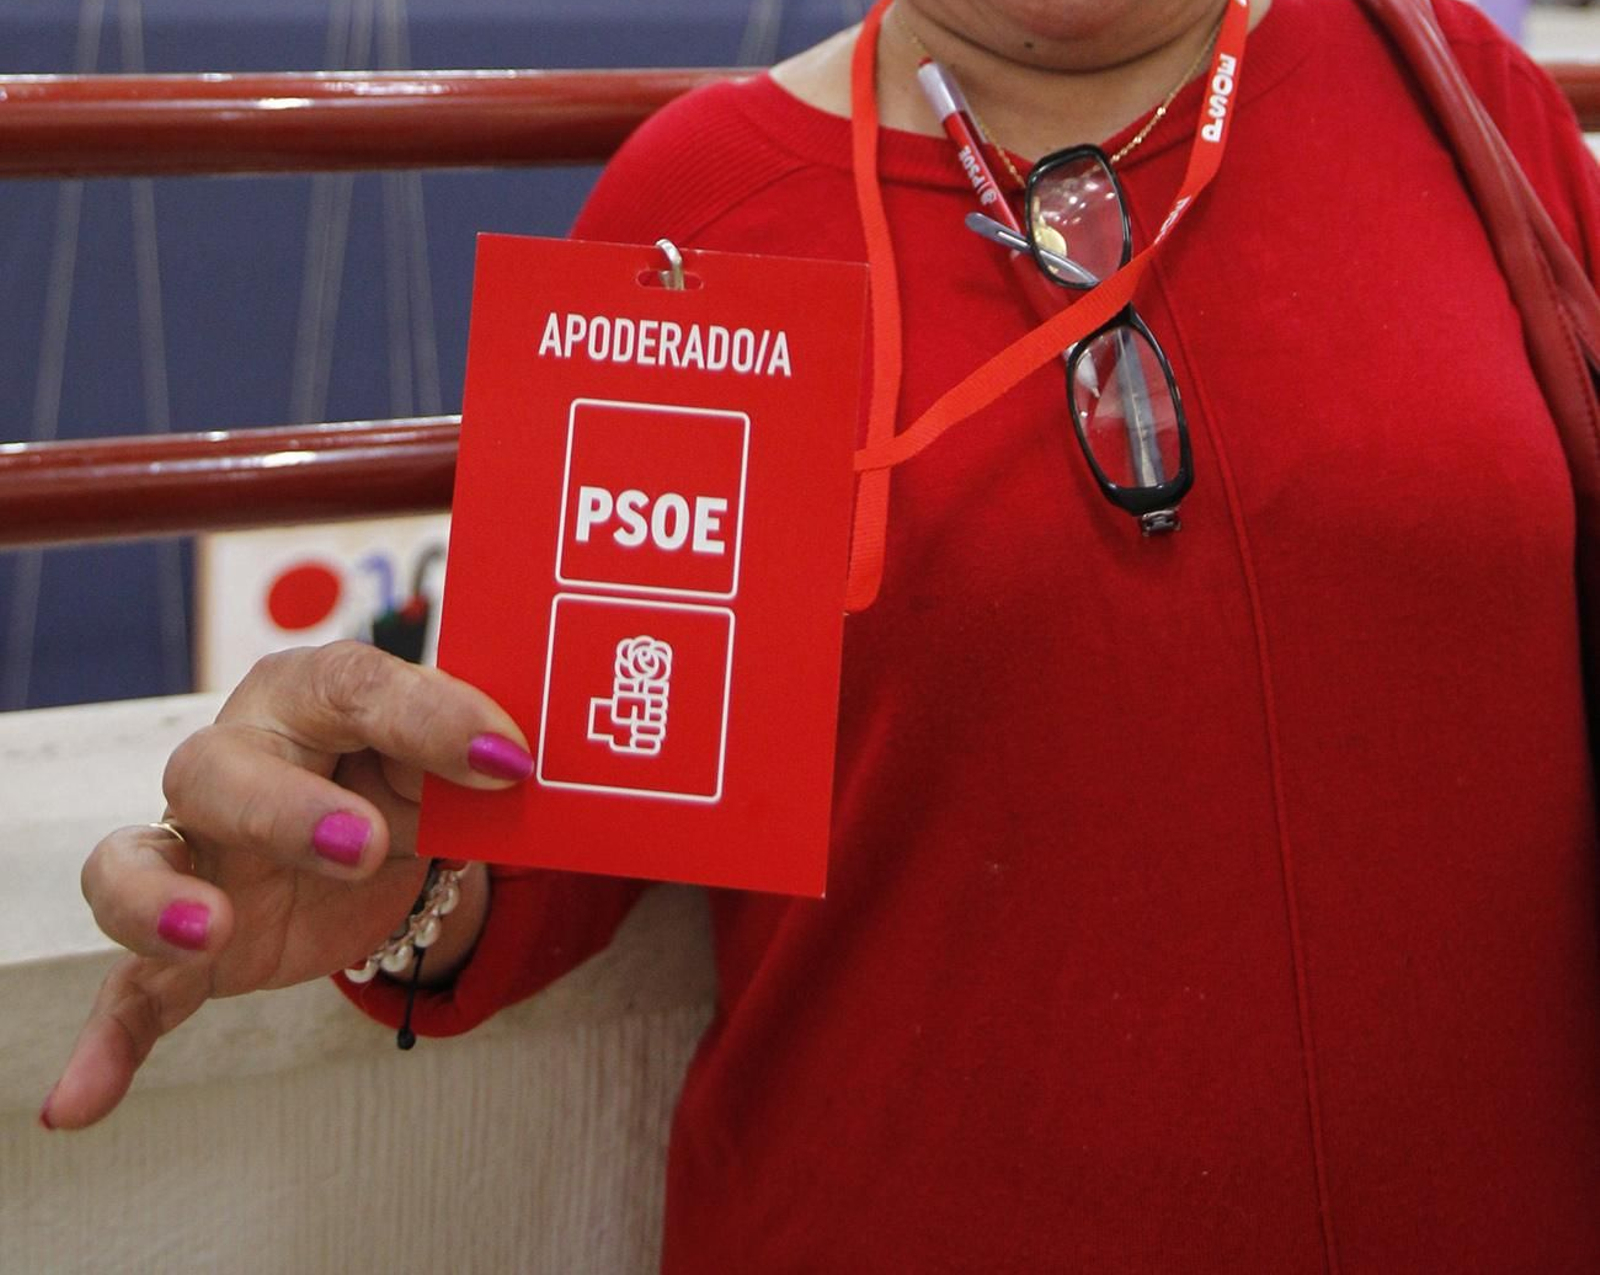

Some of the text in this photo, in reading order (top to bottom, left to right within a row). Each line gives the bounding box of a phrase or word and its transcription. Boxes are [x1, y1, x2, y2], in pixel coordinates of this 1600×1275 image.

[1201, 52, 1237, 143] PSOE
[958, 145, 986, 189] PSOE
[538, 312, 792, 377] APODERADO/A
[575, 485, 728, 555] PSOE
